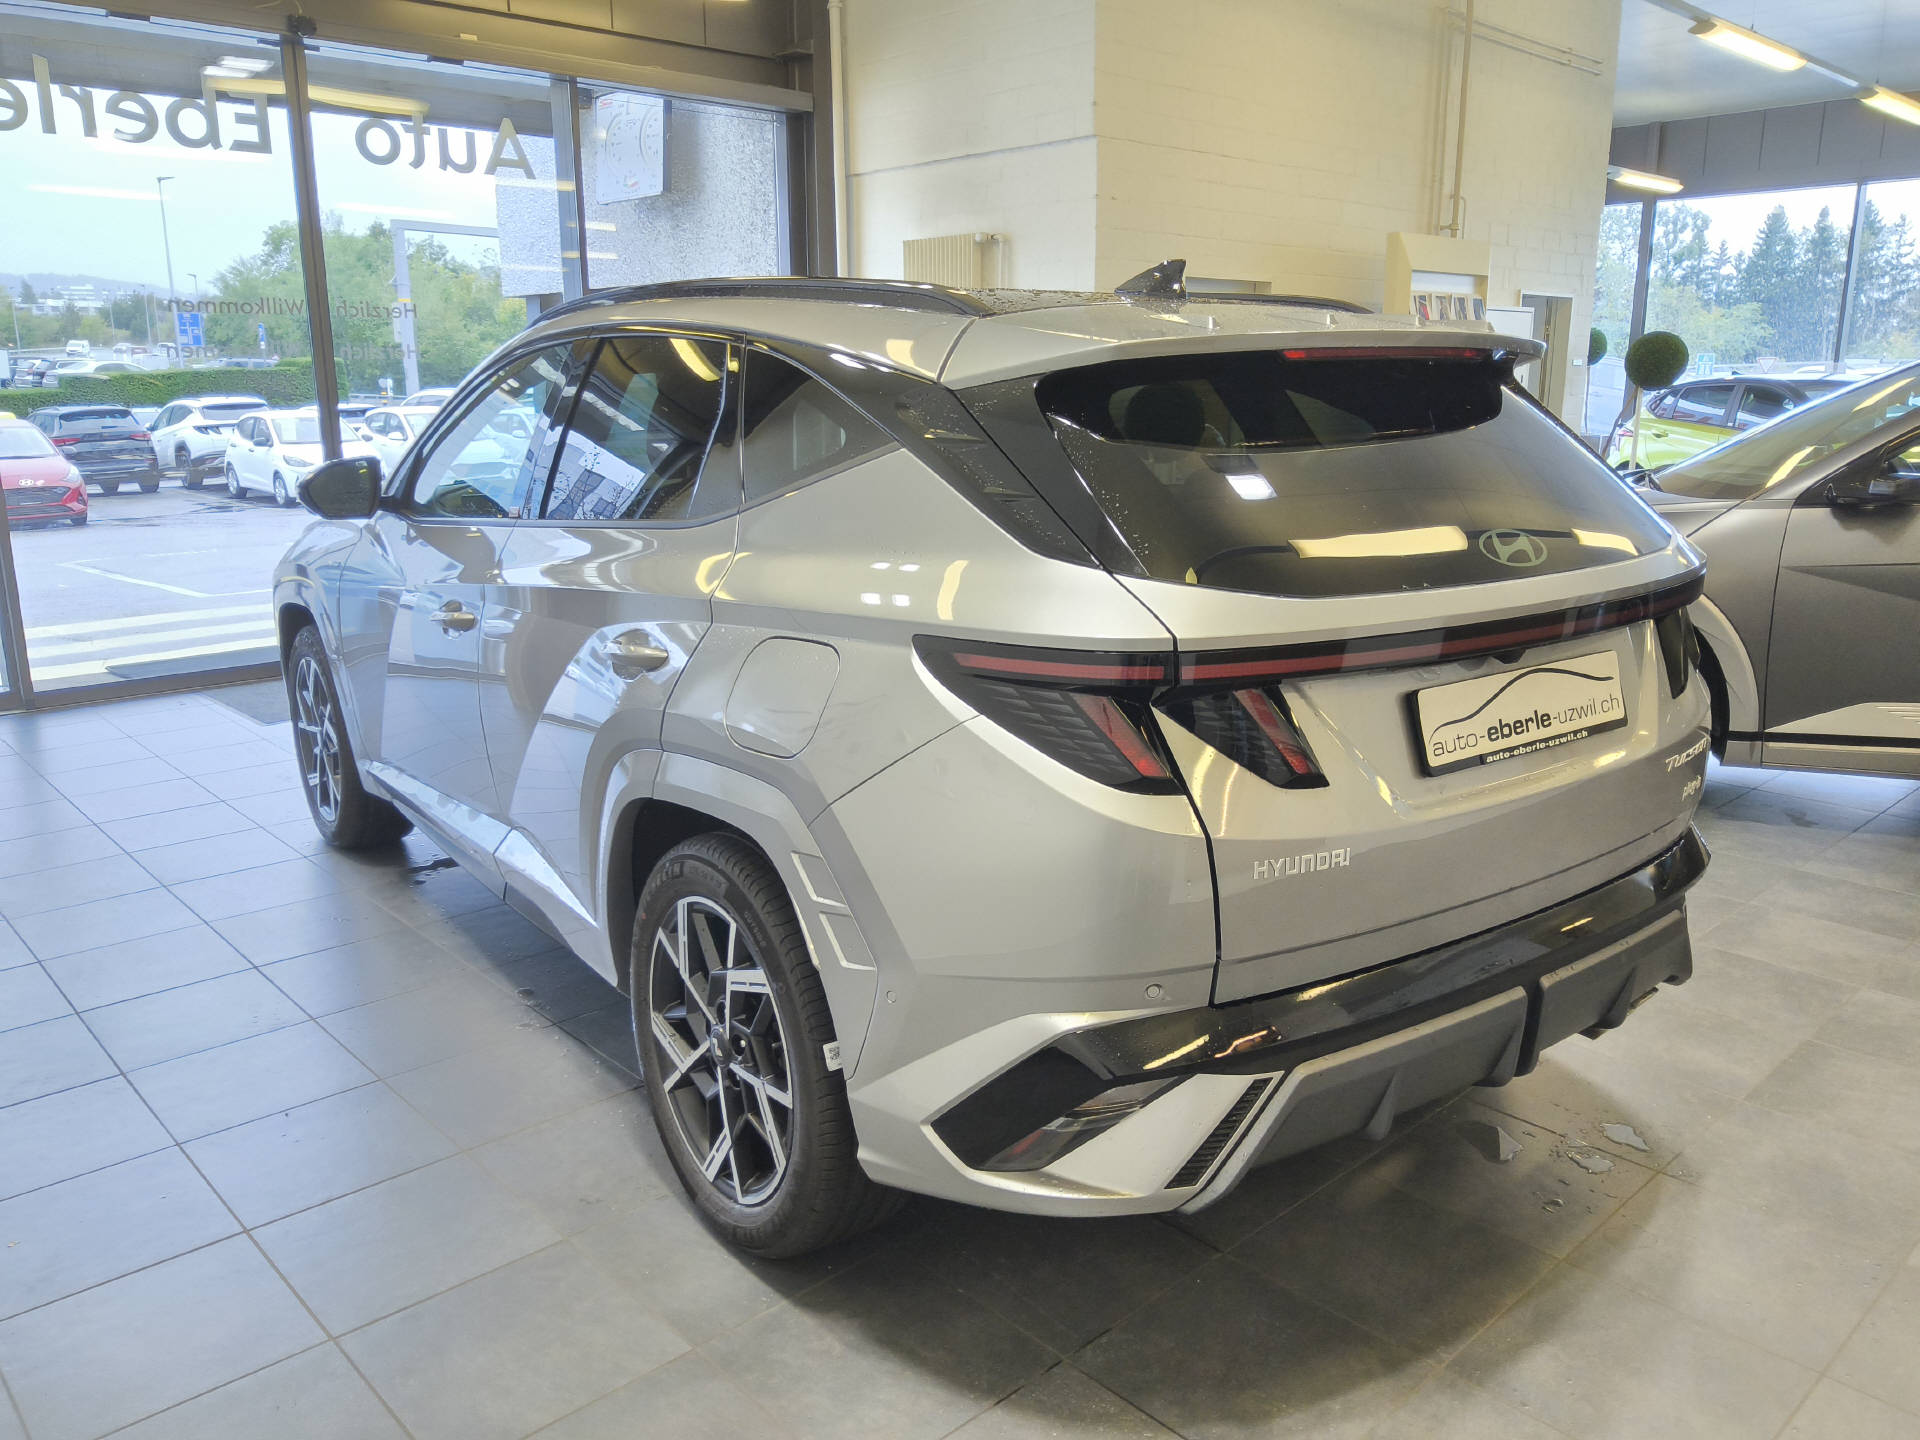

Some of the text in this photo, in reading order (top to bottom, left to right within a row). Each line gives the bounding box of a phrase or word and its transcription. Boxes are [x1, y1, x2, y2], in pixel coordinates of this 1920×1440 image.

[1432, 693, 1620, 758] auto-eberle-uzwil.ch
[1486, 729, 1588, 764] auto-eberle-uzwil.ch
[1253, 847, 1351, 880] HYUNDAI
